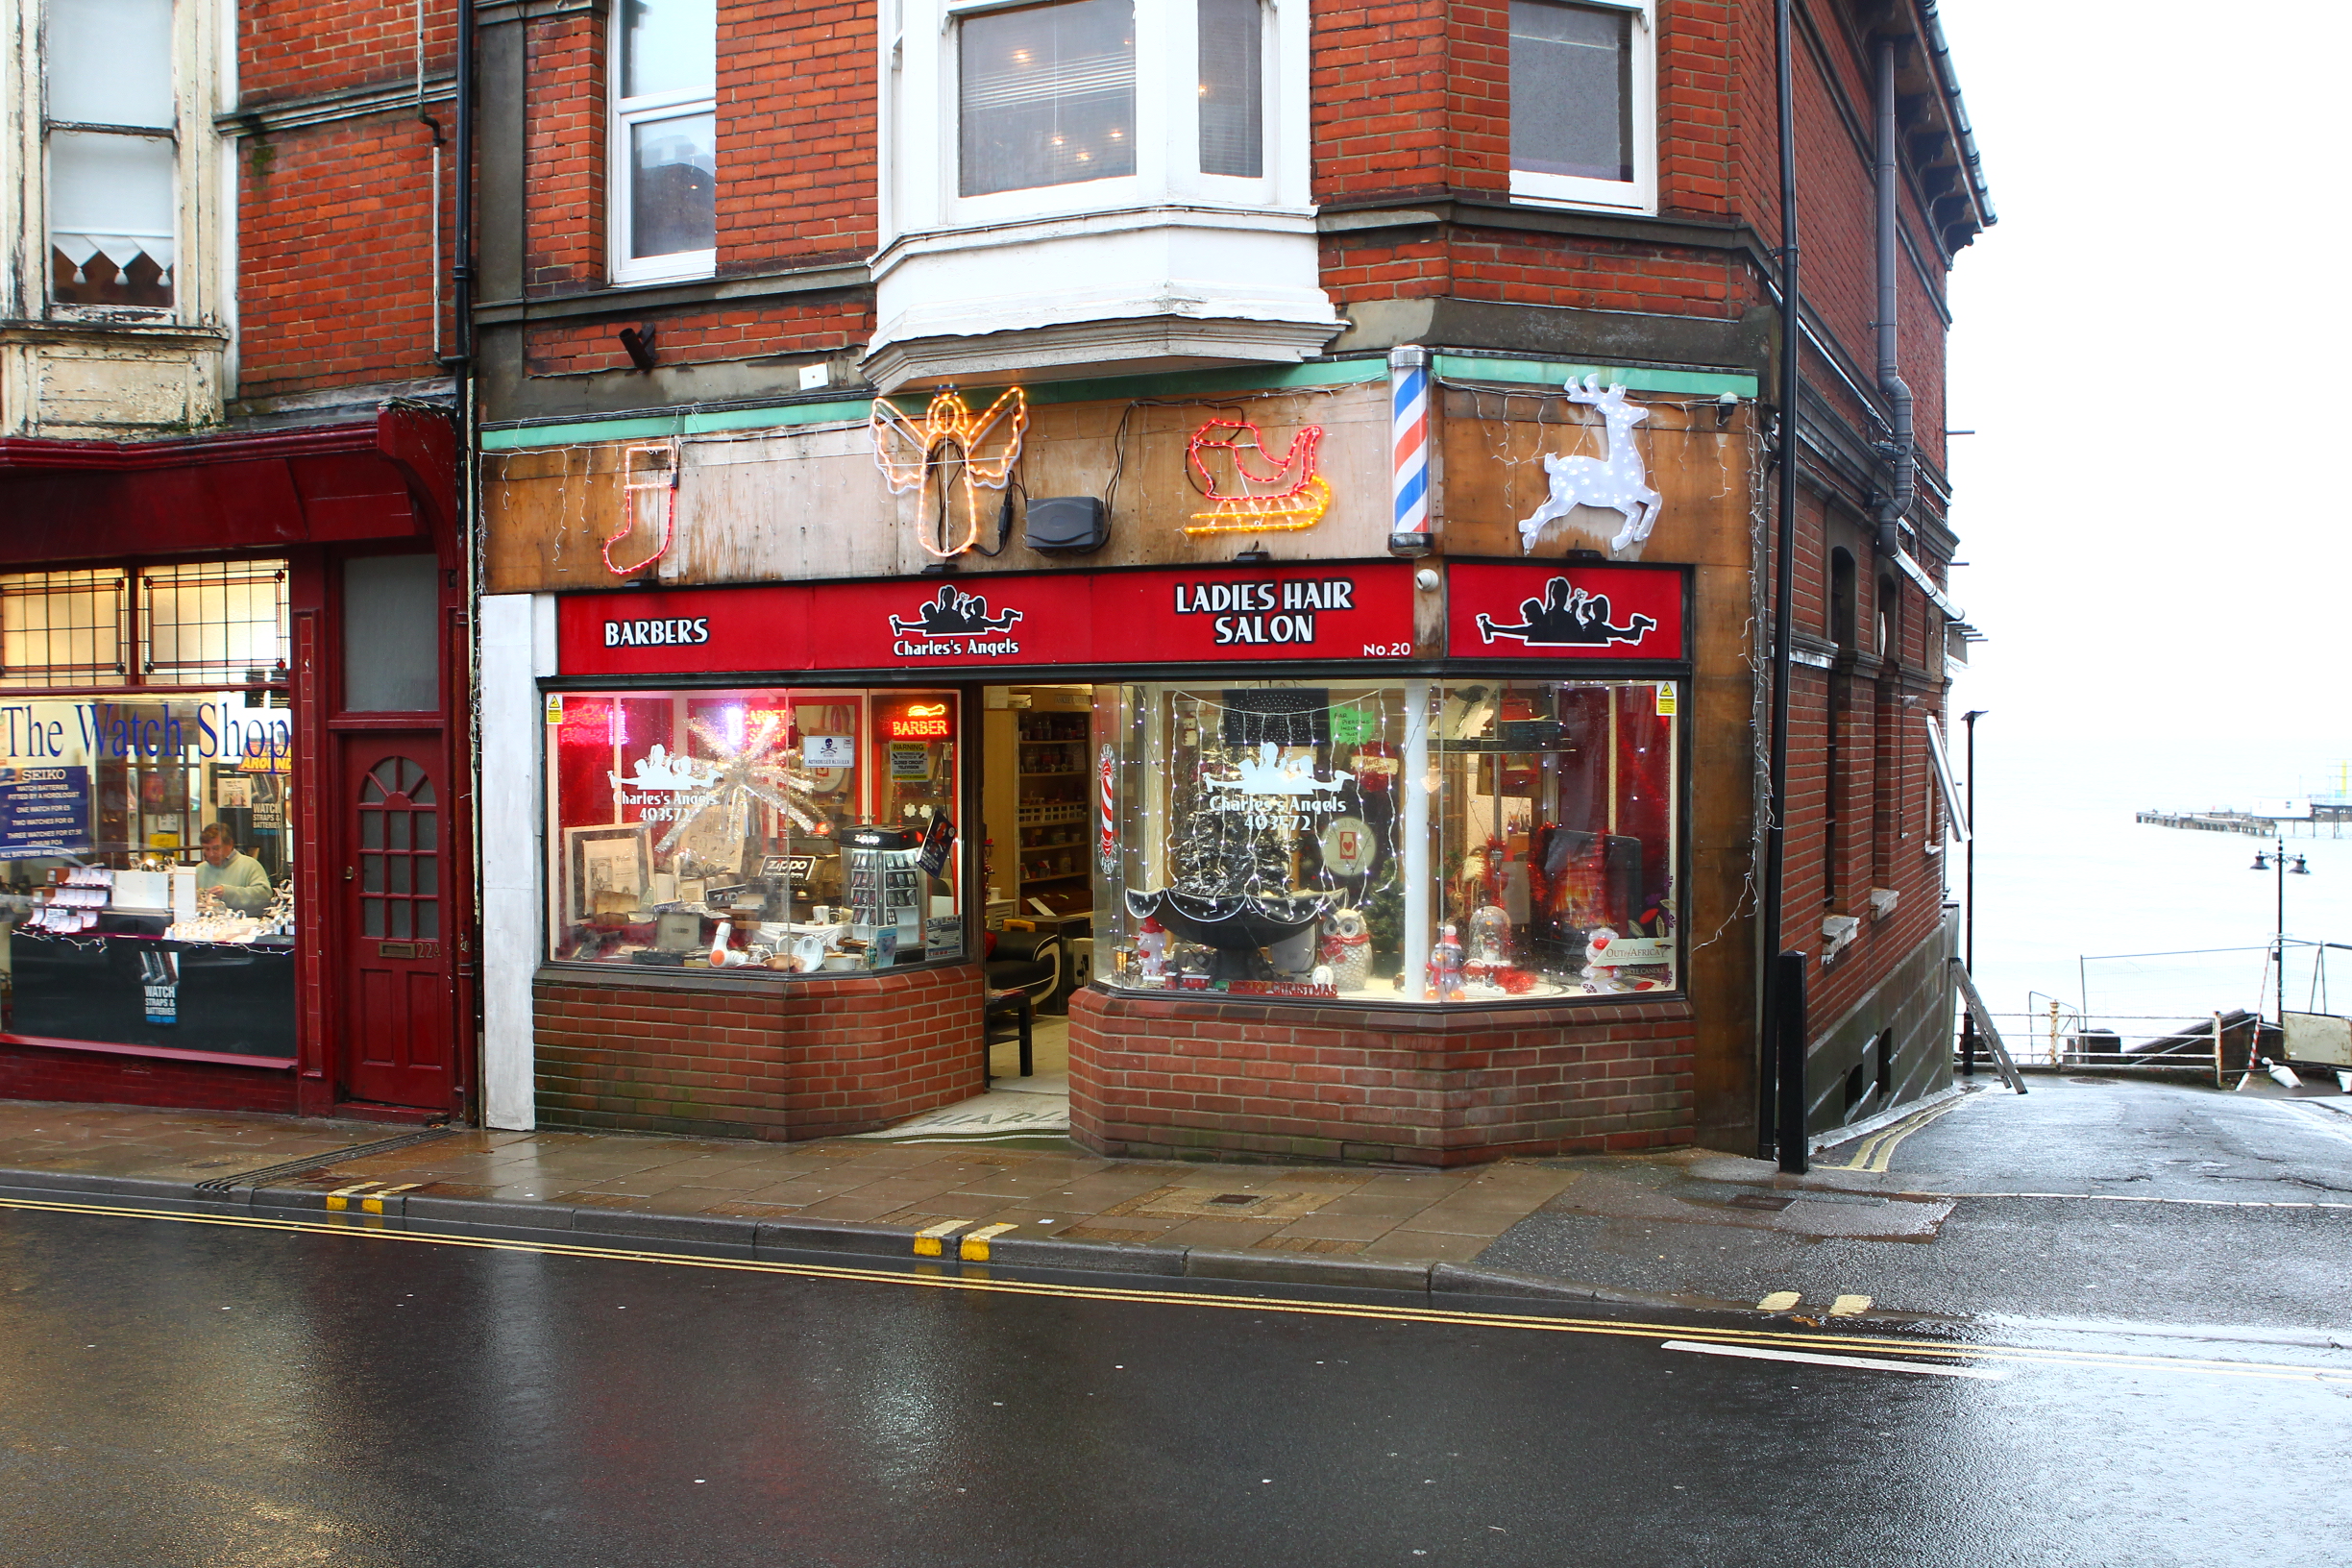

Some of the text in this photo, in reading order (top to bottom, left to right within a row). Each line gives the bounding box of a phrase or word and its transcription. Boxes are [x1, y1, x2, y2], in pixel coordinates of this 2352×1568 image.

[1176, 581, 1353, 613] LADIES HAIR
[604, 618, 709, 647] BARBERS
[1214, 615, 1312, 644] SALON
[893, 637, 1019, 656] Charles's Angels
[1362, 642, 1410, 656] No.20
[893, 721, 948, 736] BARBER
[1, 704, 63, 757] The
[74, 701, 184, 757] Watch
[197, 701, 291, 774] Shop
[22, 769, 67, 781] SEIKO
[613, 791, 718, 806] Charles's Angels
[1210, 796, 1347, 815] Charles's Angels
[1244, 815, 1311, 831] 403572
[416, 943, 441, 958] 22A
[1606, 948, 1625, 957] OUT
[1630, 948, 1660, 956] AFRICA
[144, 986, 175, 998] WATCH
[1272, 981, 1338, 995] CHRISTMAS
[145, 998, 168, 1006] STRAPS
[146, 1007, 176, 1015] BATTERIES
